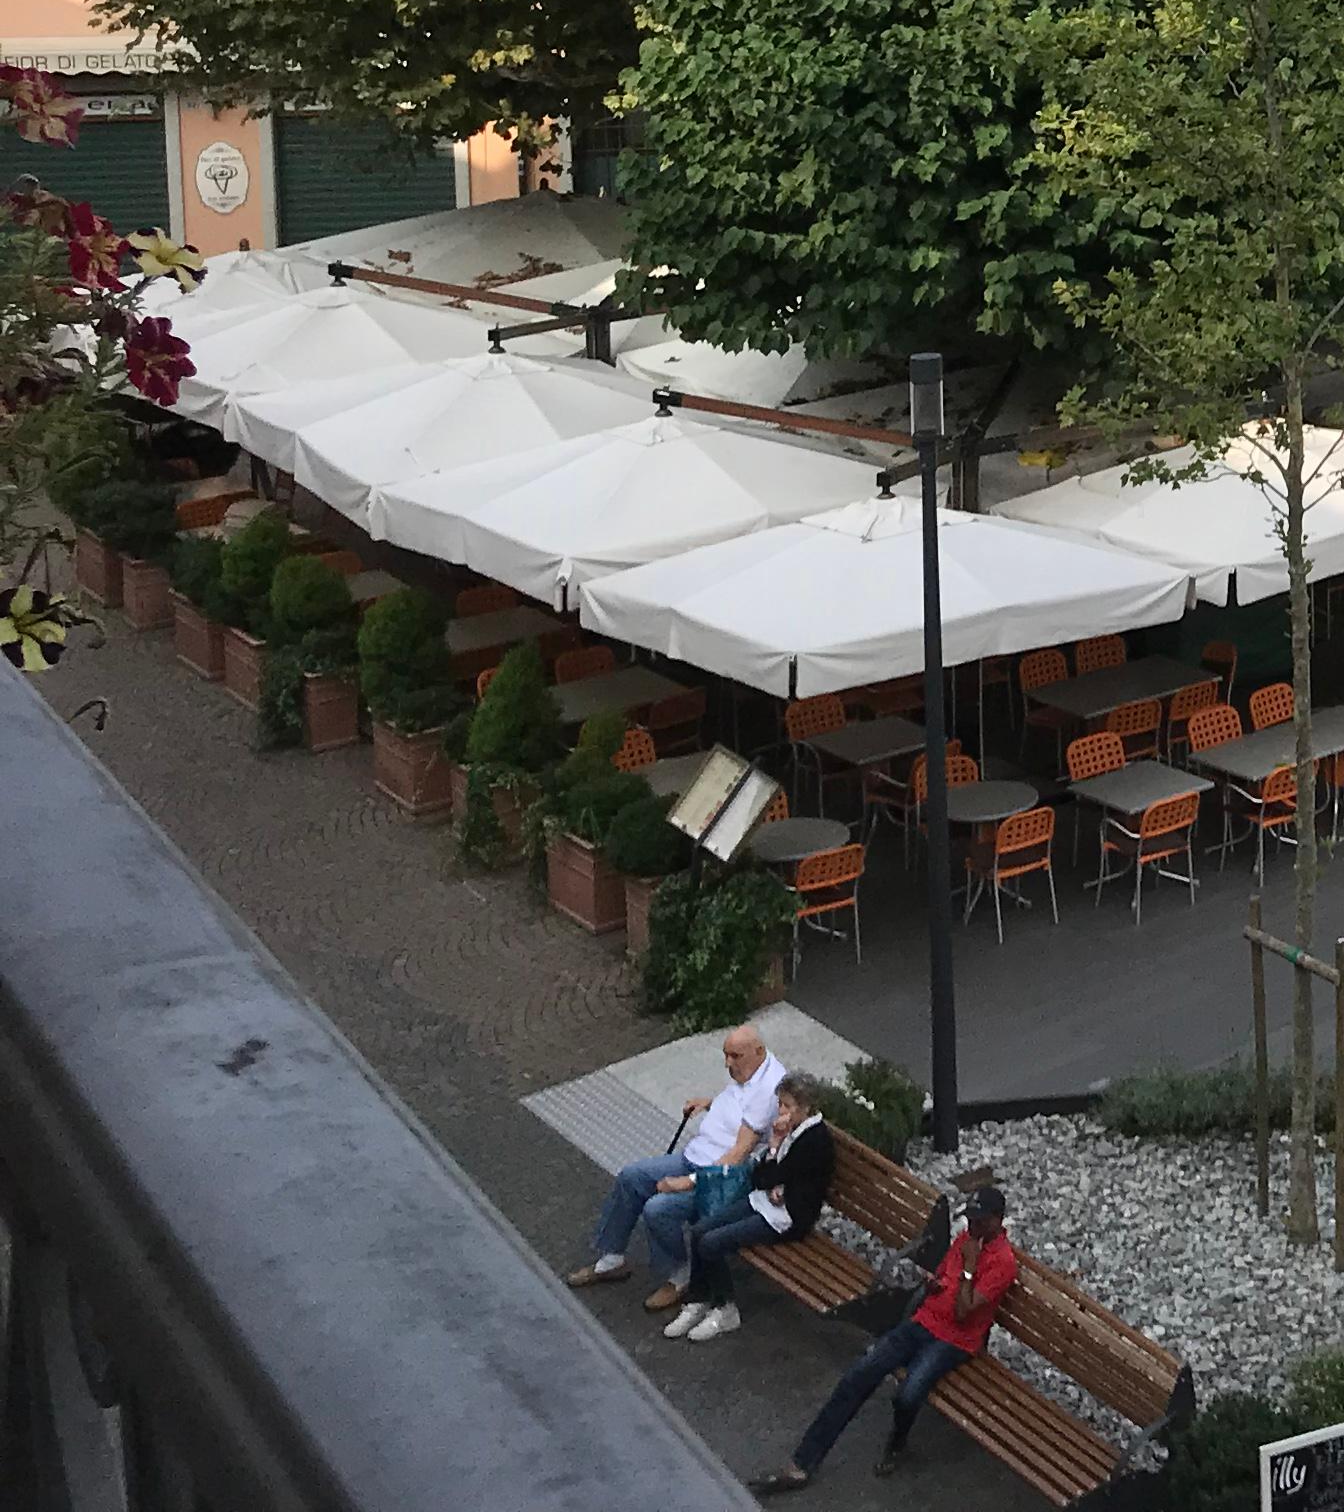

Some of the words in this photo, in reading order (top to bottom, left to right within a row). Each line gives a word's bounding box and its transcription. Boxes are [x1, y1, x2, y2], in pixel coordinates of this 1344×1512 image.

[5, 55, 48, 70] FIOR
[58, 55, 76, 70] DI
[1272, 1454, 1307, 1495] illy
